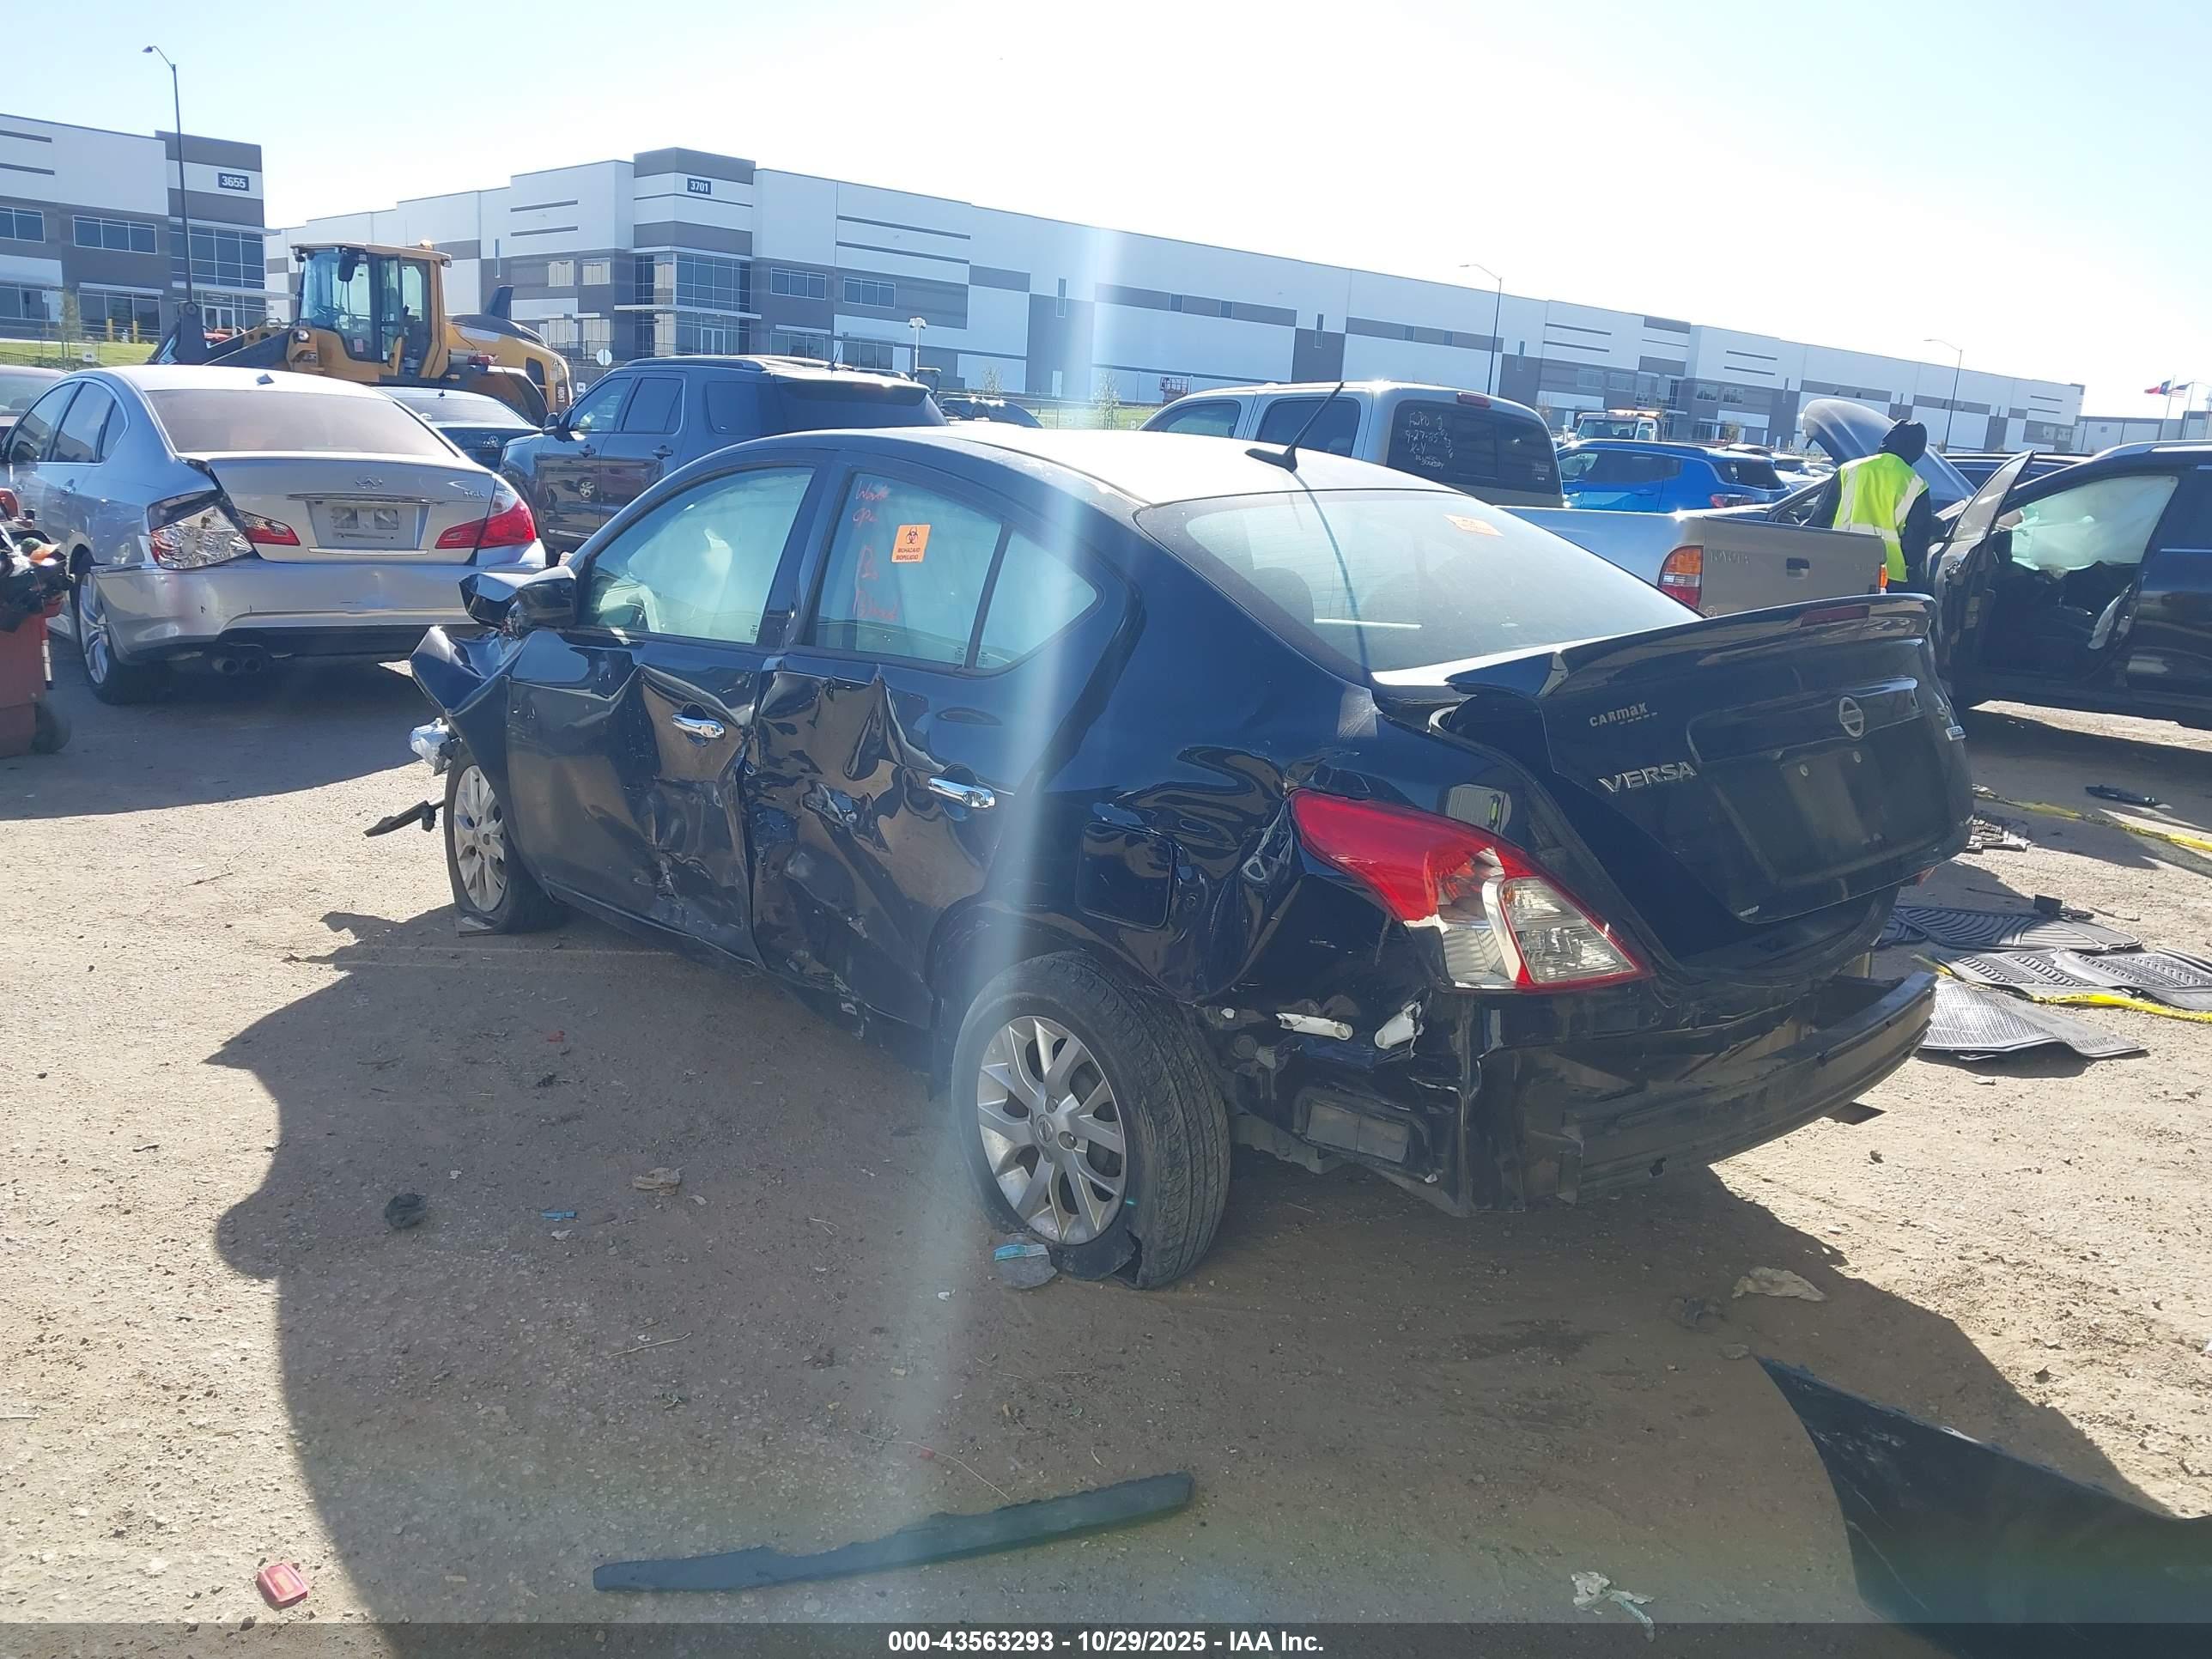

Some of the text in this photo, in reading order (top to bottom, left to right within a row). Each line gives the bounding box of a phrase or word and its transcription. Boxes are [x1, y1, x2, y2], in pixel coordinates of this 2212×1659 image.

[222, 175, 246, 188] 3655
[690, 180, 708, 192] 3701
[1597, 761, 1698, 793] VERSA
